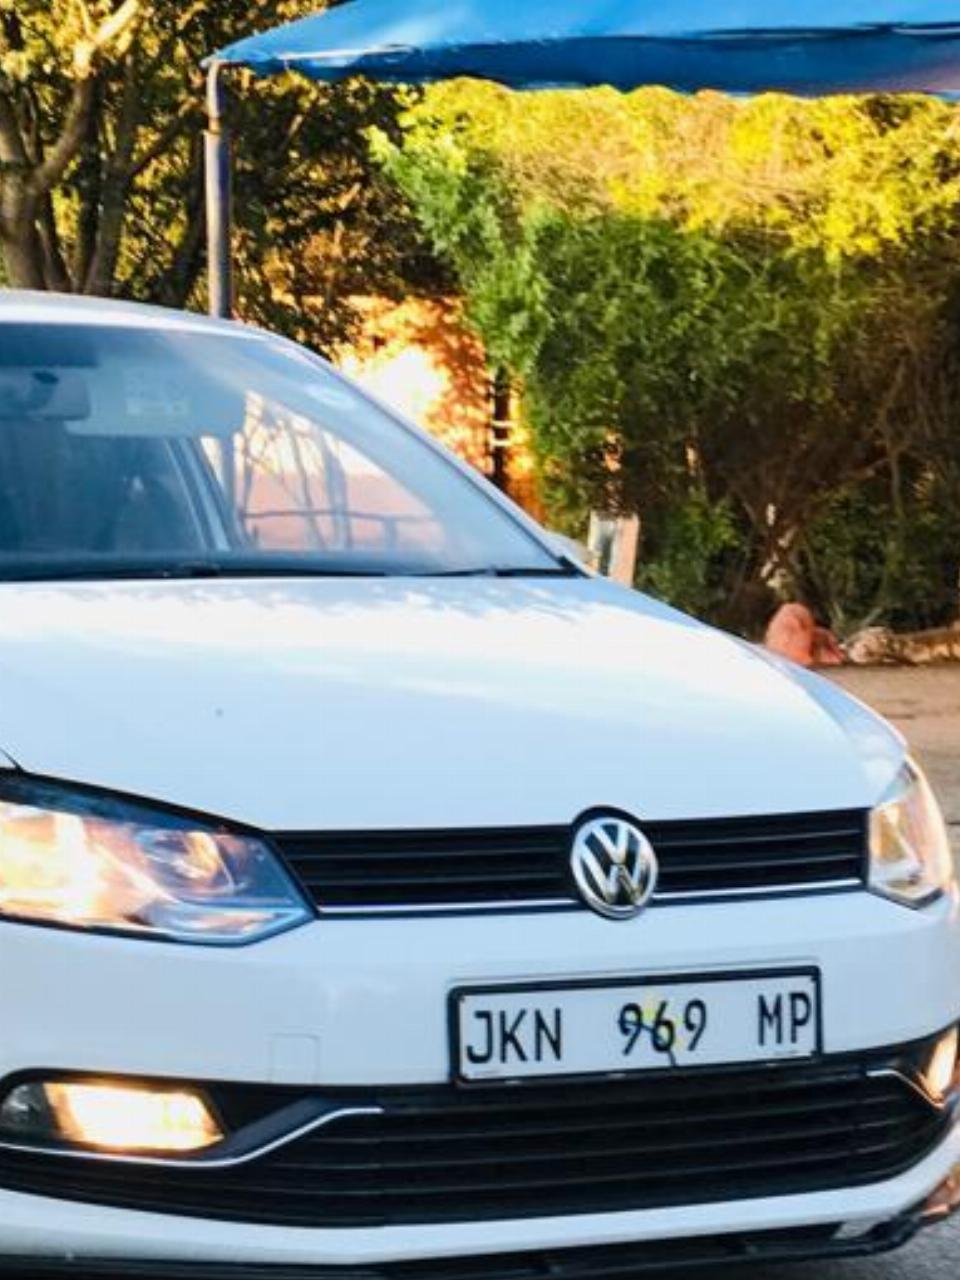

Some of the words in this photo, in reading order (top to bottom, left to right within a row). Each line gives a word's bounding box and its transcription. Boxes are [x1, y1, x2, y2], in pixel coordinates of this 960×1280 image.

[574, 820, 652, 907] VW
[466, 1008, 563, 1064] JKN
[618, 999, 708, 1056] 969
[757, 991, 812, 1046] MP
